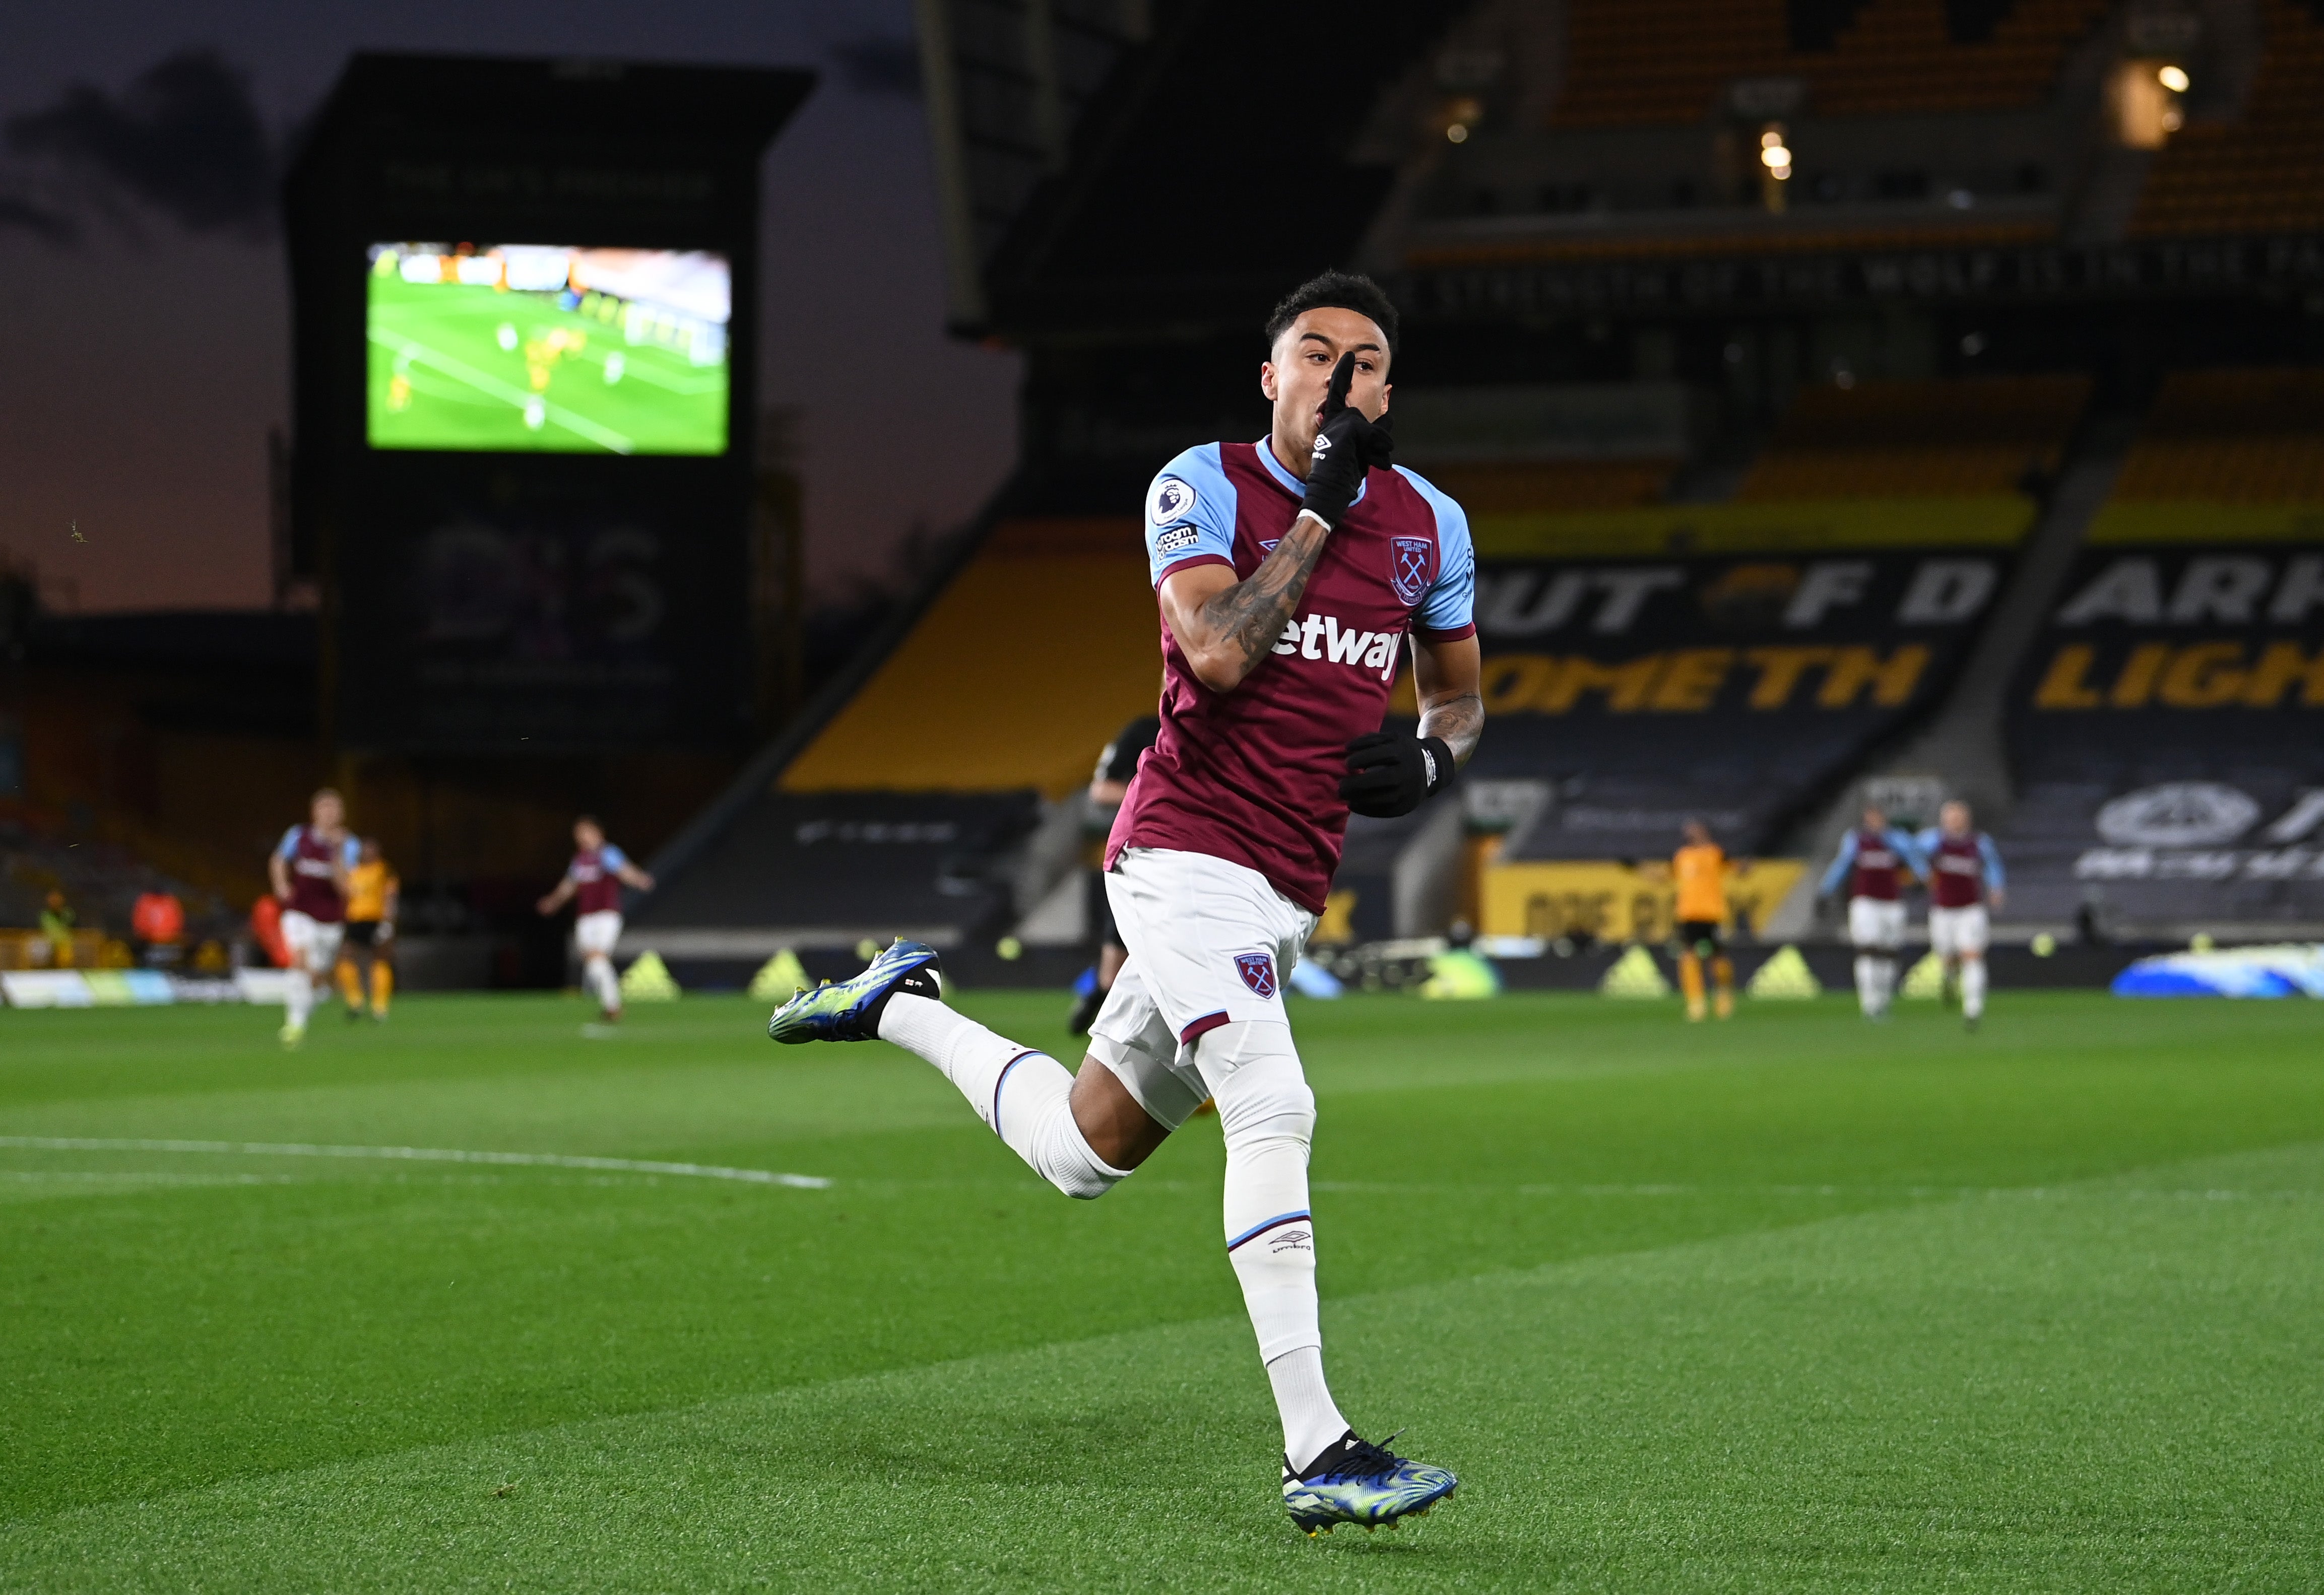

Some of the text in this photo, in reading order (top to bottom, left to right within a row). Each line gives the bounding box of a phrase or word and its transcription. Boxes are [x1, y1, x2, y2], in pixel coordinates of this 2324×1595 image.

[1160, 526, 1192, 545] room
[1163, 535, 1199, 552] racism
[1413, 541, 1428, 550] HAM
[1474, 568, 1683, 634] UT
[1270, 613, 1403, 681] etway
[1273, 1243, 1311, 1253] umbro
